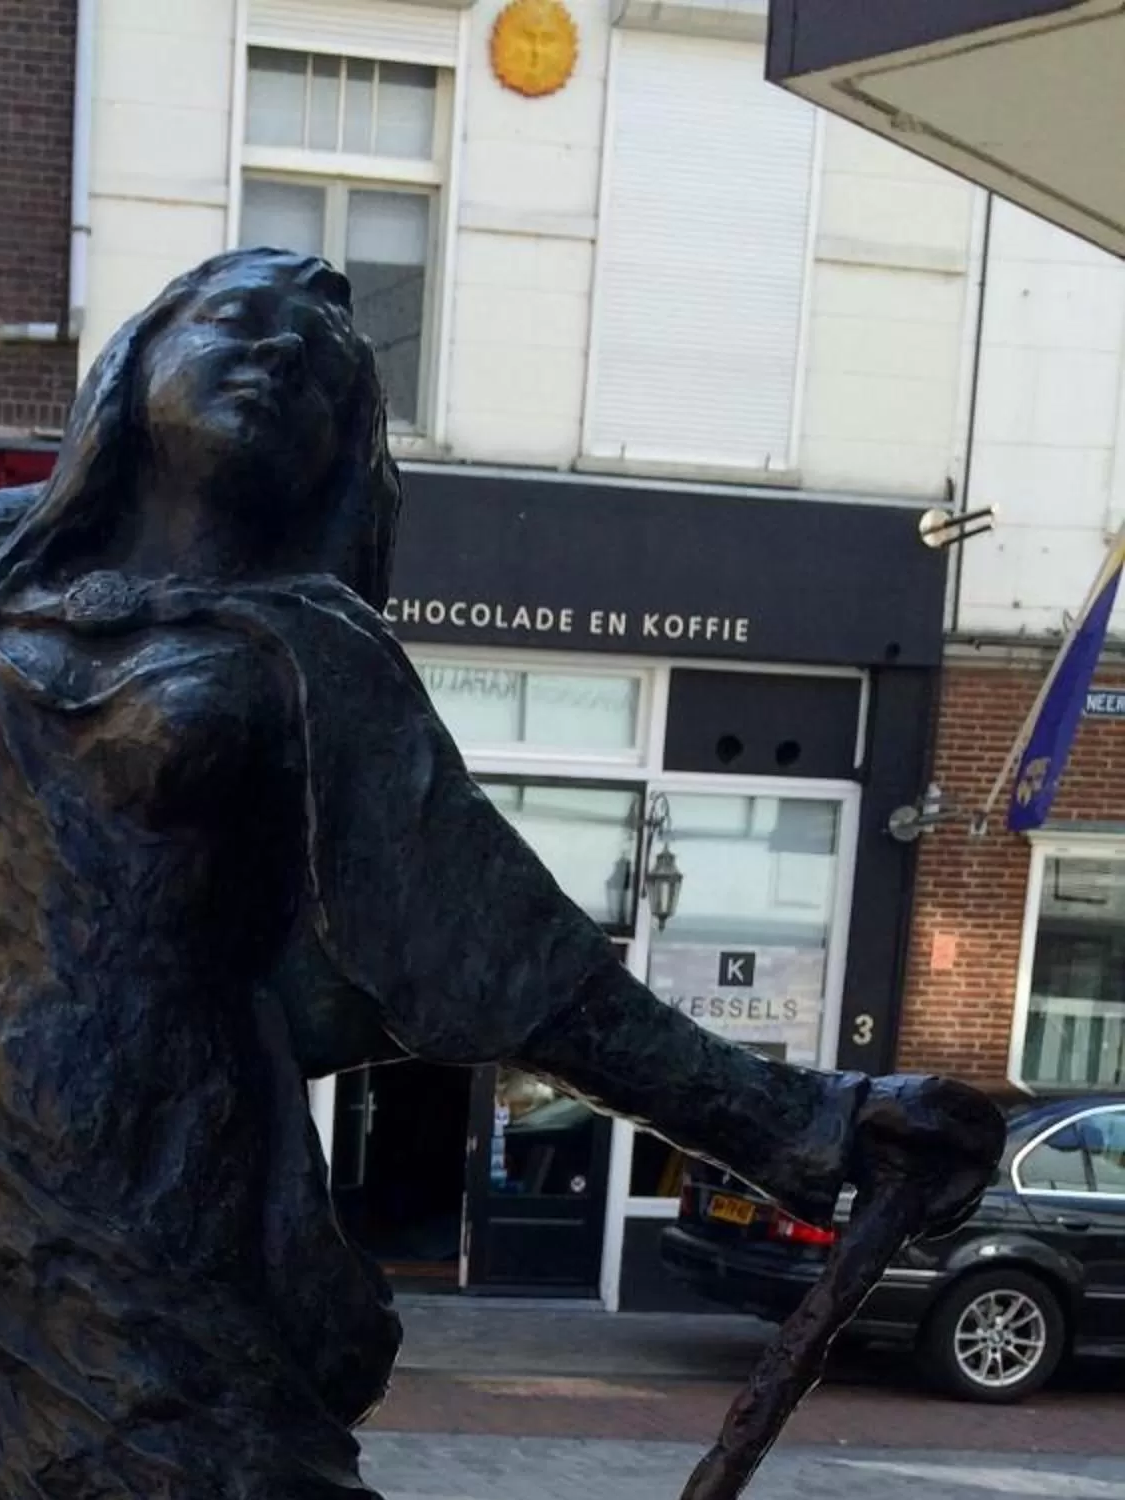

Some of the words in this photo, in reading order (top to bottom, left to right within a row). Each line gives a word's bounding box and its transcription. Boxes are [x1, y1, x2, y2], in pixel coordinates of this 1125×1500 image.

[382, 598, 574, 633] CHOCOLADE
[590, 611, 626, 637] EN
[642, 613, 750, 643] KOFFIE
[726, 958, 747, 983] K
[851, 1012, 875, 1046] 3
